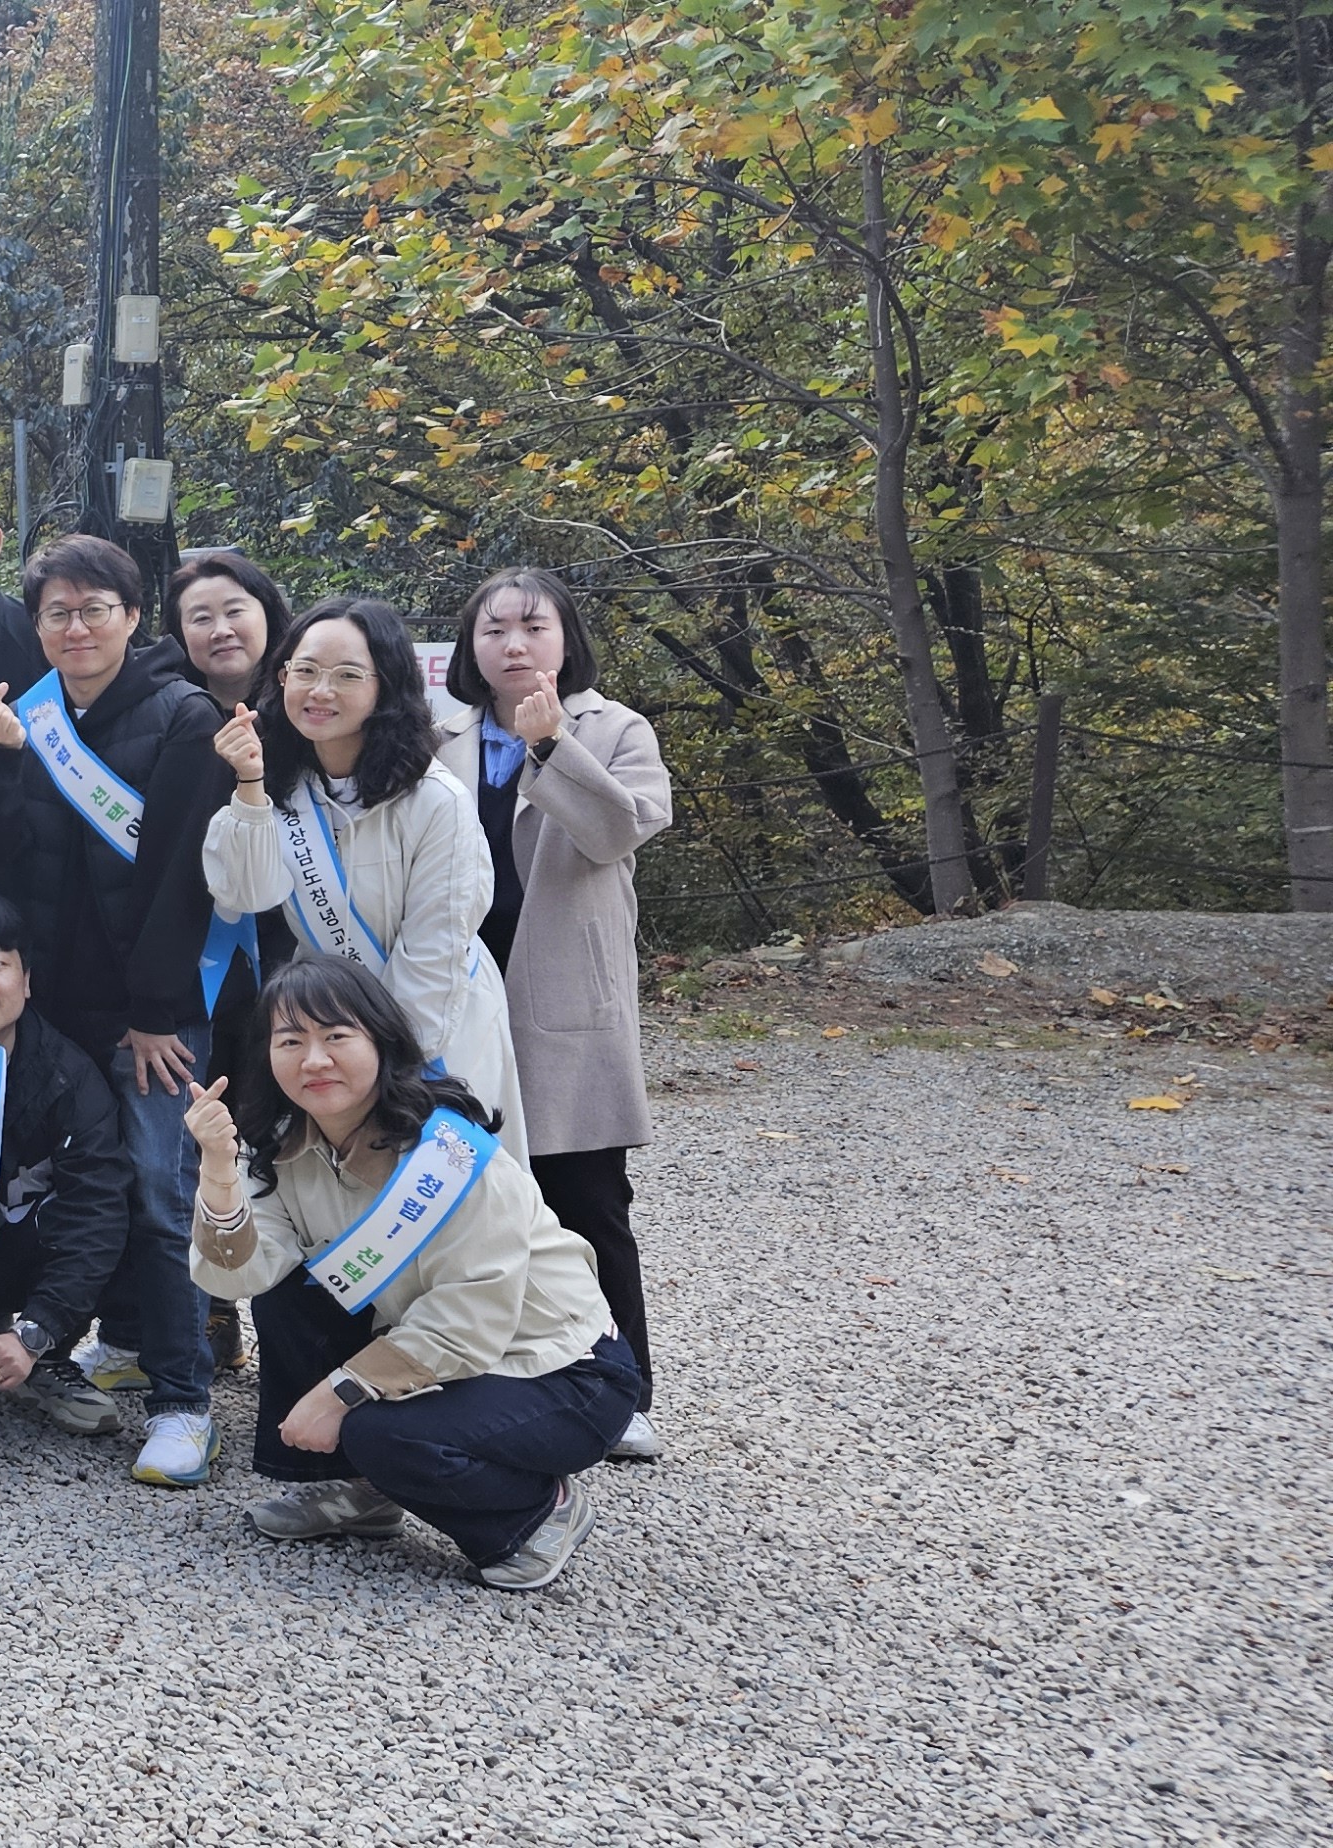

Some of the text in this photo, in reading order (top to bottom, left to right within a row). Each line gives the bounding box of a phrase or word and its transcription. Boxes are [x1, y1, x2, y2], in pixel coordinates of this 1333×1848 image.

[44, 726, 83, 780] 청렴!
[327, 1173, 445, 1294] 청렴! 선택이
